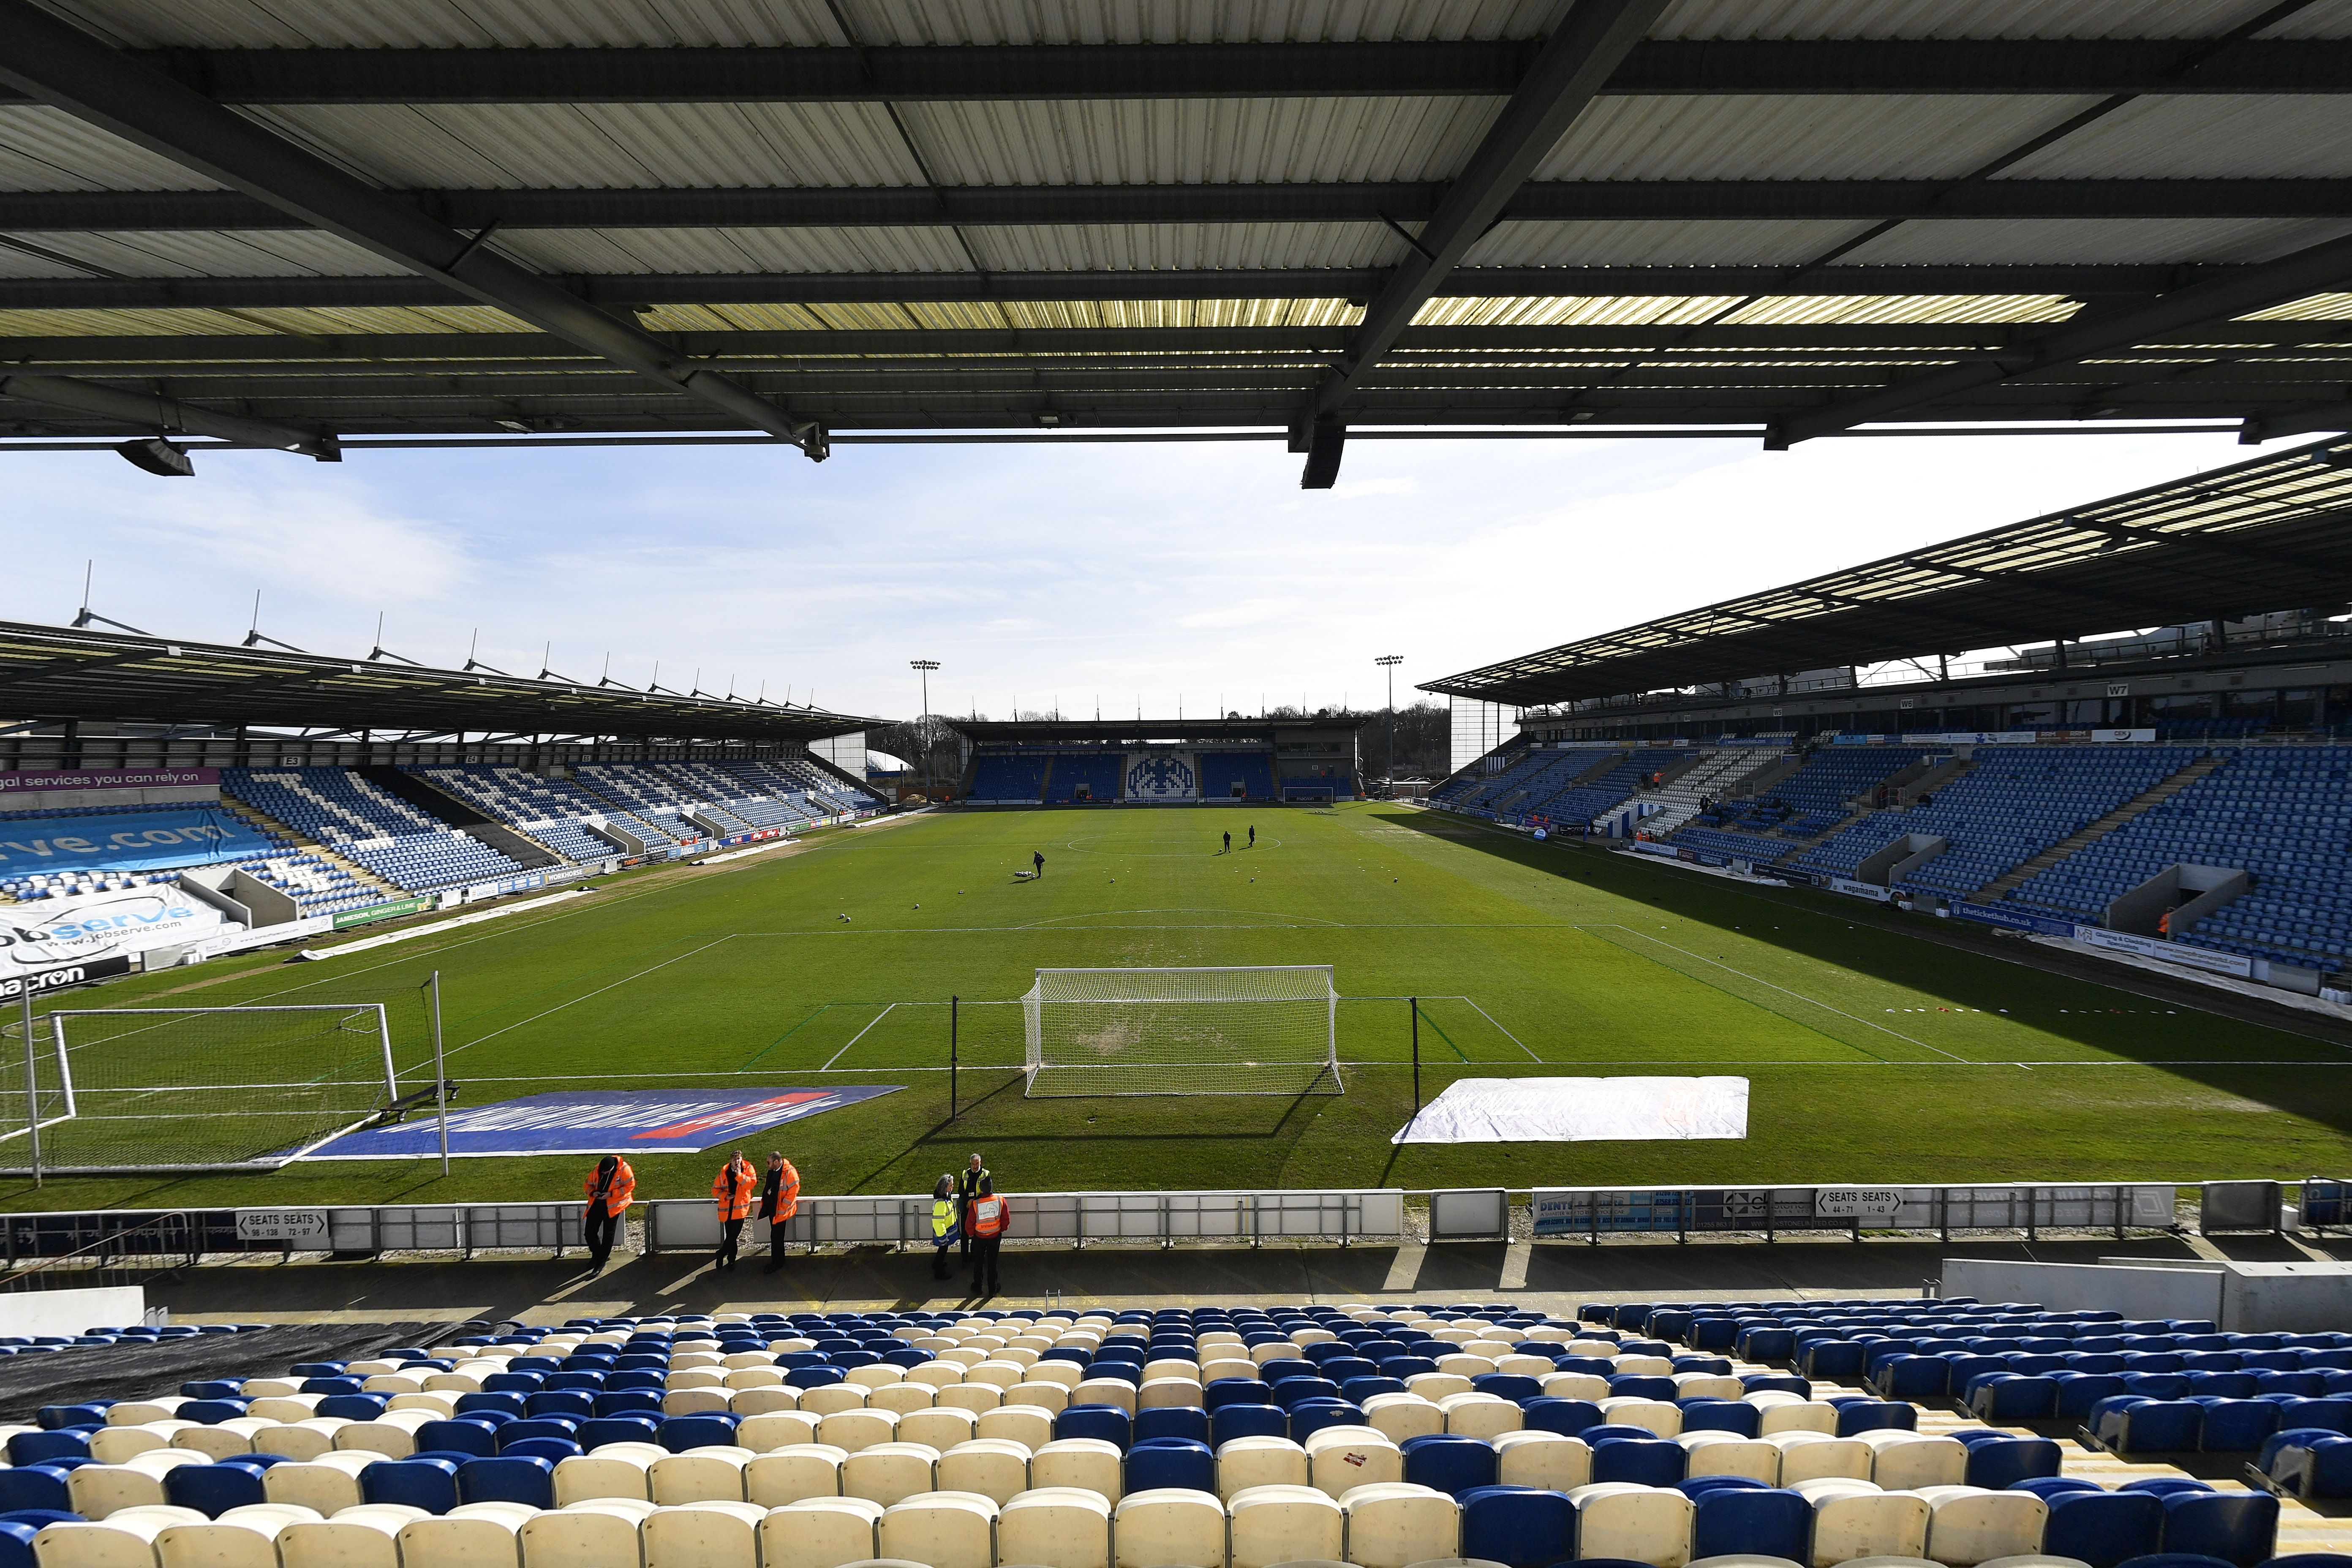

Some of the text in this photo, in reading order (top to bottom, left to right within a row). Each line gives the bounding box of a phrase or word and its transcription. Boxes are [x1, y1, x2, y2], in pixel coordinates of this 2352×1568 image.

[2109, 686, 2126, 694] W7
[286, 757, 298, 765] E3
[24, 776, 91, 786] services
[95, 776, 122, 787] you
[156, 773, 180, 784] rely
[680, 847, 695, 856] Atlas
[1843, 885, 1878, 897] wagamama
[335, 912, 370, 923] JAMESON,
[371, 905, 396, 916] GINGER
[1963, 907, 2032, 926] thetickethub.co.uk
[2124, 937, 2151, 947] Cladding
[1829, 1192, 1891, 1202] SEATS SEATS
[249, 1214, 314, 1225] SEATS SEATS
